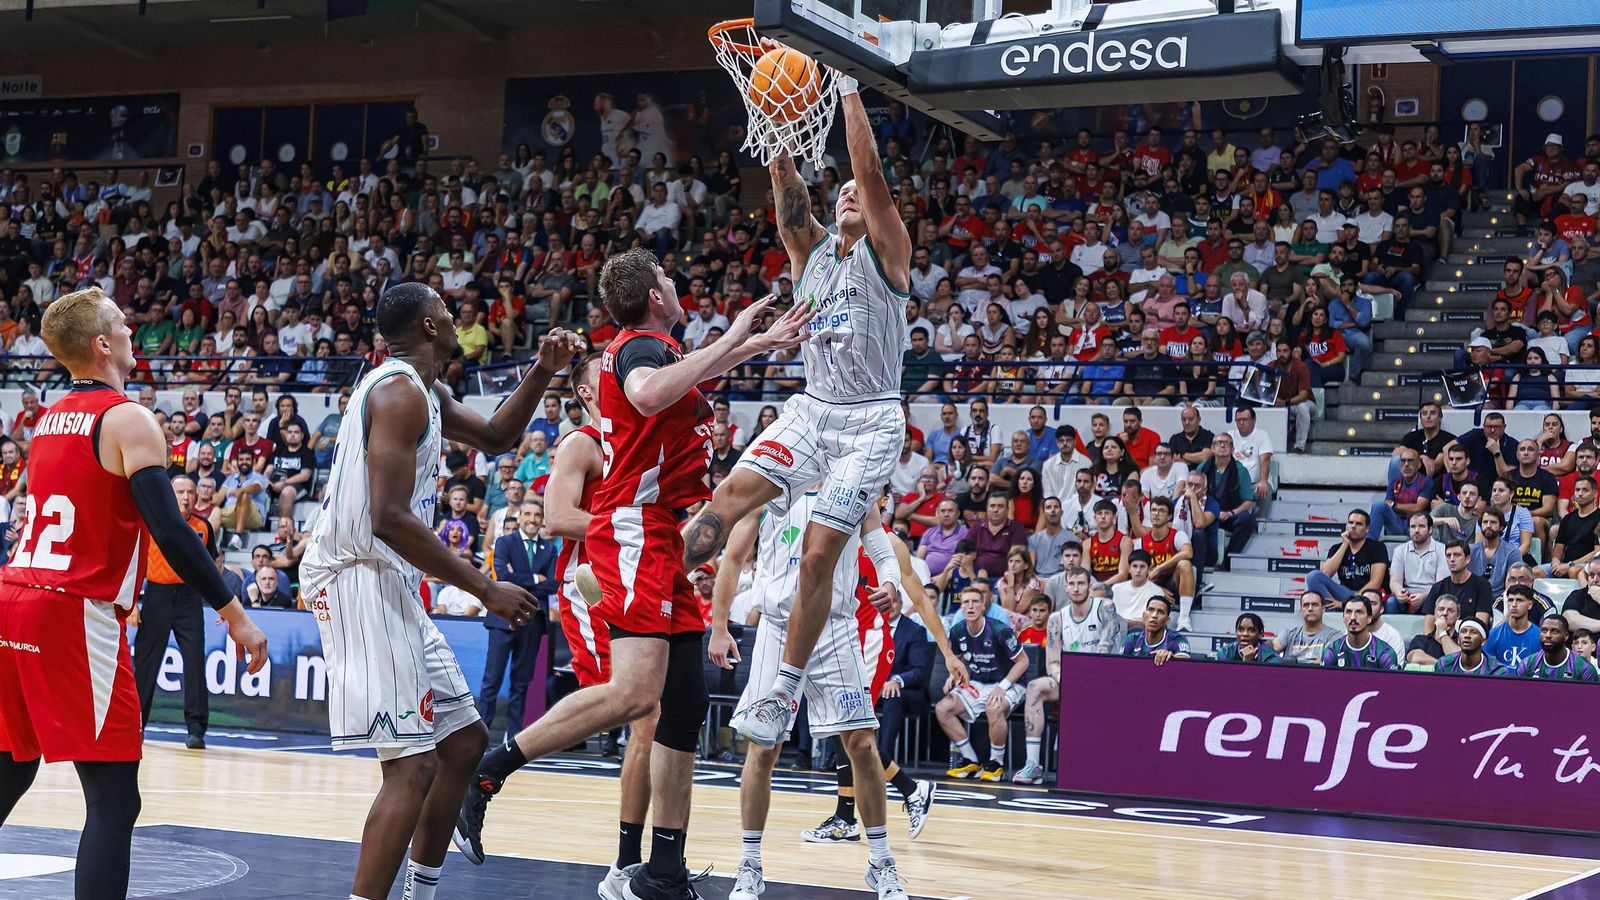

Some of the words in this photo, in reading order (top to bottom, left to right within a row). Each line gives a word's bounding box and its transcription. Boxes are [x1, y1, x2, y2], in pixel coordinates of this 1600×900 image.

[1000, 31, 1188, 76] endesa
[1, 80, 38, 94] Norte
[807, 312, 849, 332] málga
[702, 438, 714, 472] 3
[1515, 486, 1542, 499] CAM
[8, 494, 76, 572] 22
[205, 633, 271, 698] da
[842, 688, 861, 700] má
[1158, 690, 1430, 792] renfe
[1468, 723, 1540, 780] Tu
[1553, 734, 1600, 784] tr
